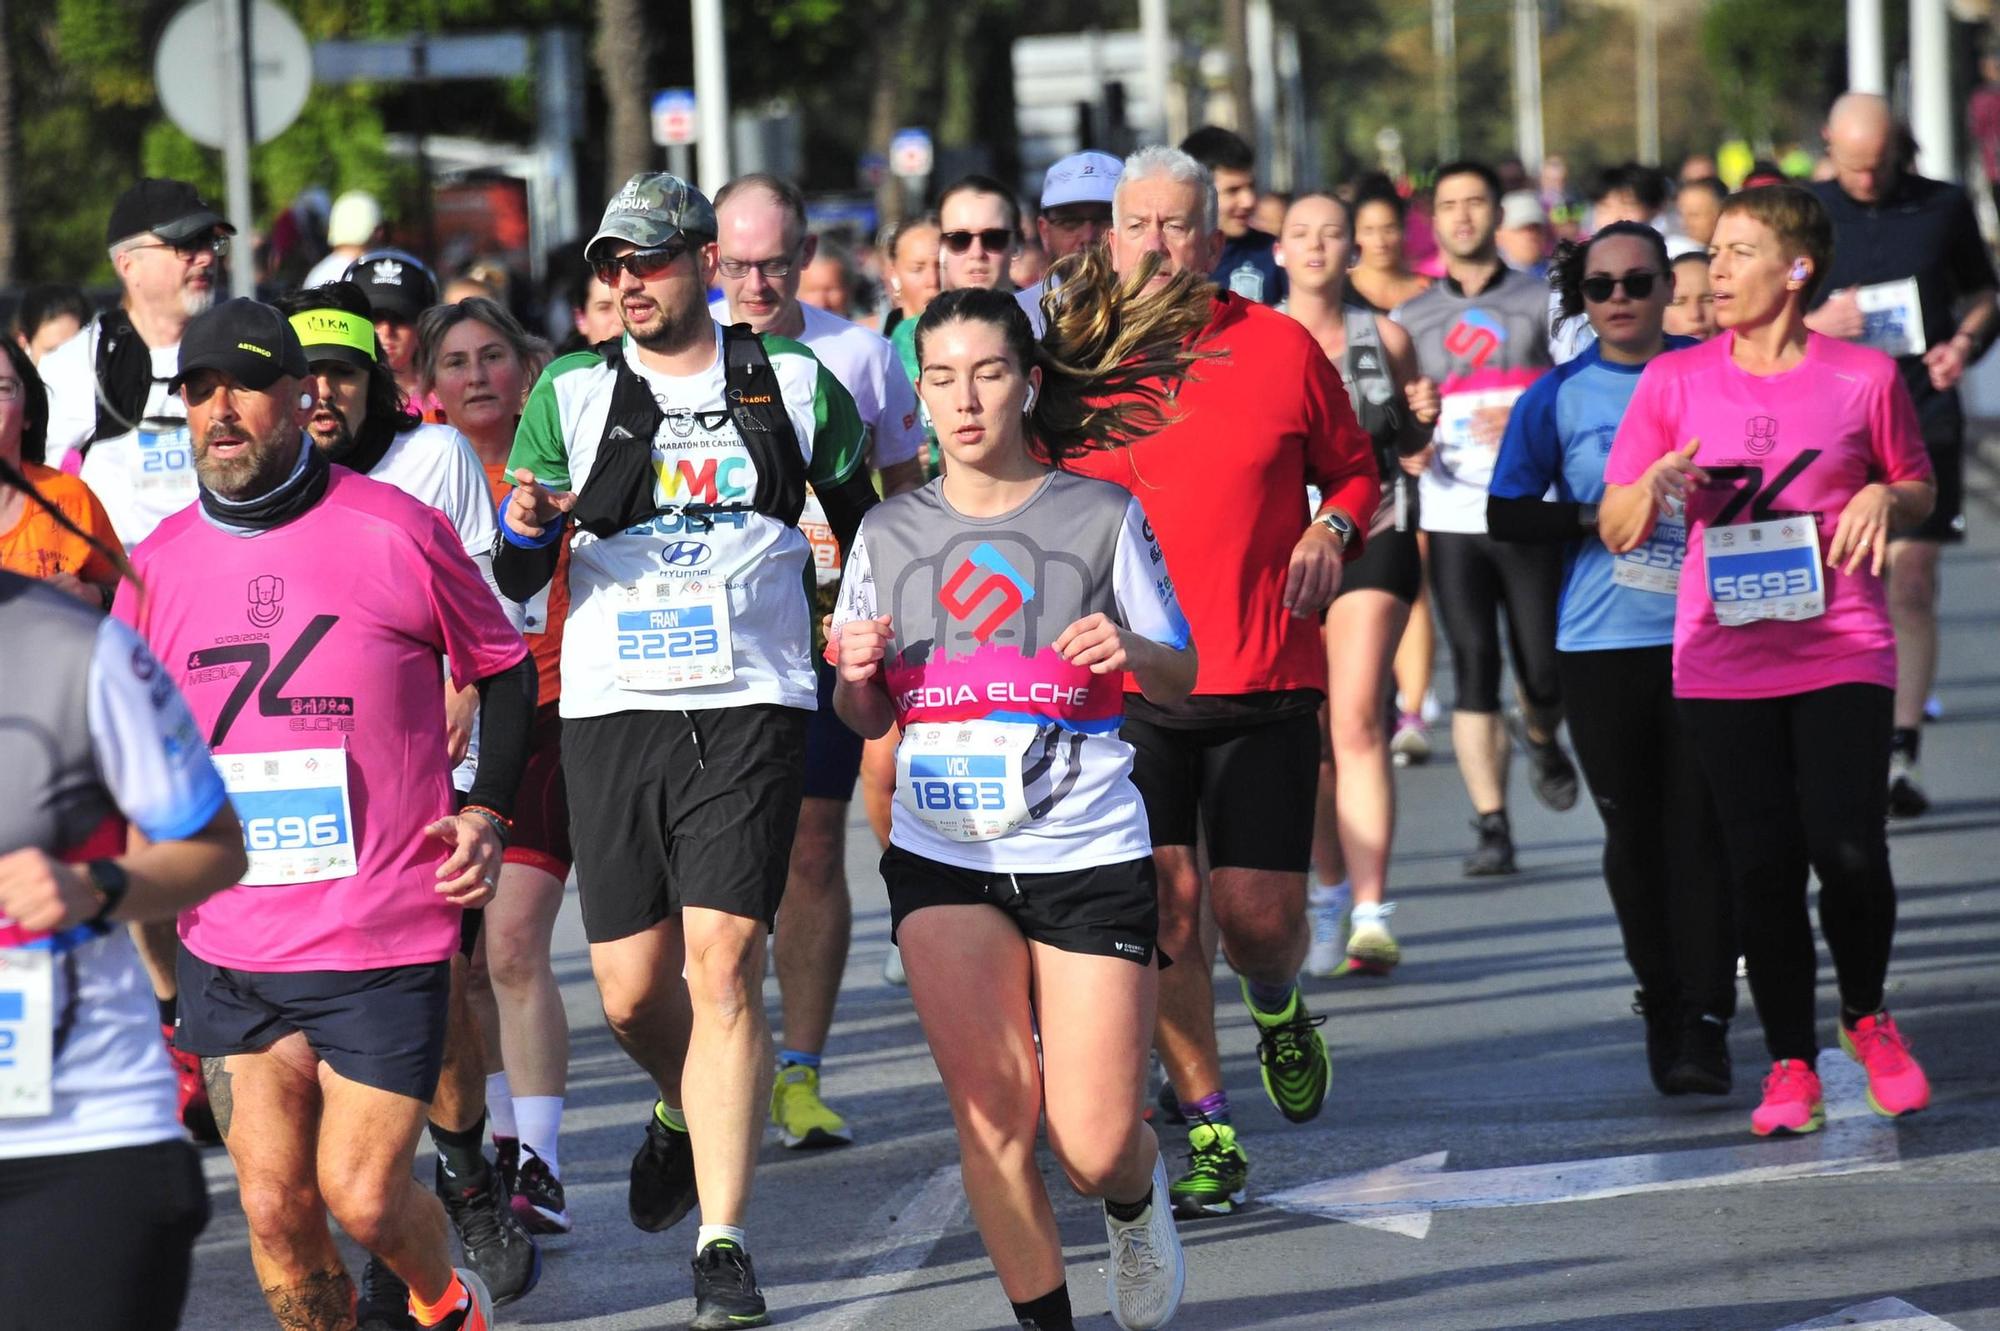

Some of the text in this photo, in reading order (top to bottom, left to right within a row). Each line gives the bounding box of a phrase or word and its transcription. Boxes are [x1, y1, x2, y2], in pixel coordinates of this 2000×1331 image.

[659, 439, 698, 451] MARATÓN
[700, 439, 711, 448] DE
[651, 456, 747, 505] VMC
[1713, 568, 1810, 601] 5693
[650, 610, 679, 629] FRAN
[214, 632, 270, 645] 10/03/2024
[617, 629, 719, 660] 2223
[188, 664, 241, 686] MEDIA
[897, 682, 1089, 714] MEDIA ELCHE
[288, 716, 356, 732] ELCHE
[946, 756, 970, 777] VICK
[912, 780, 1006, 811] 1883
